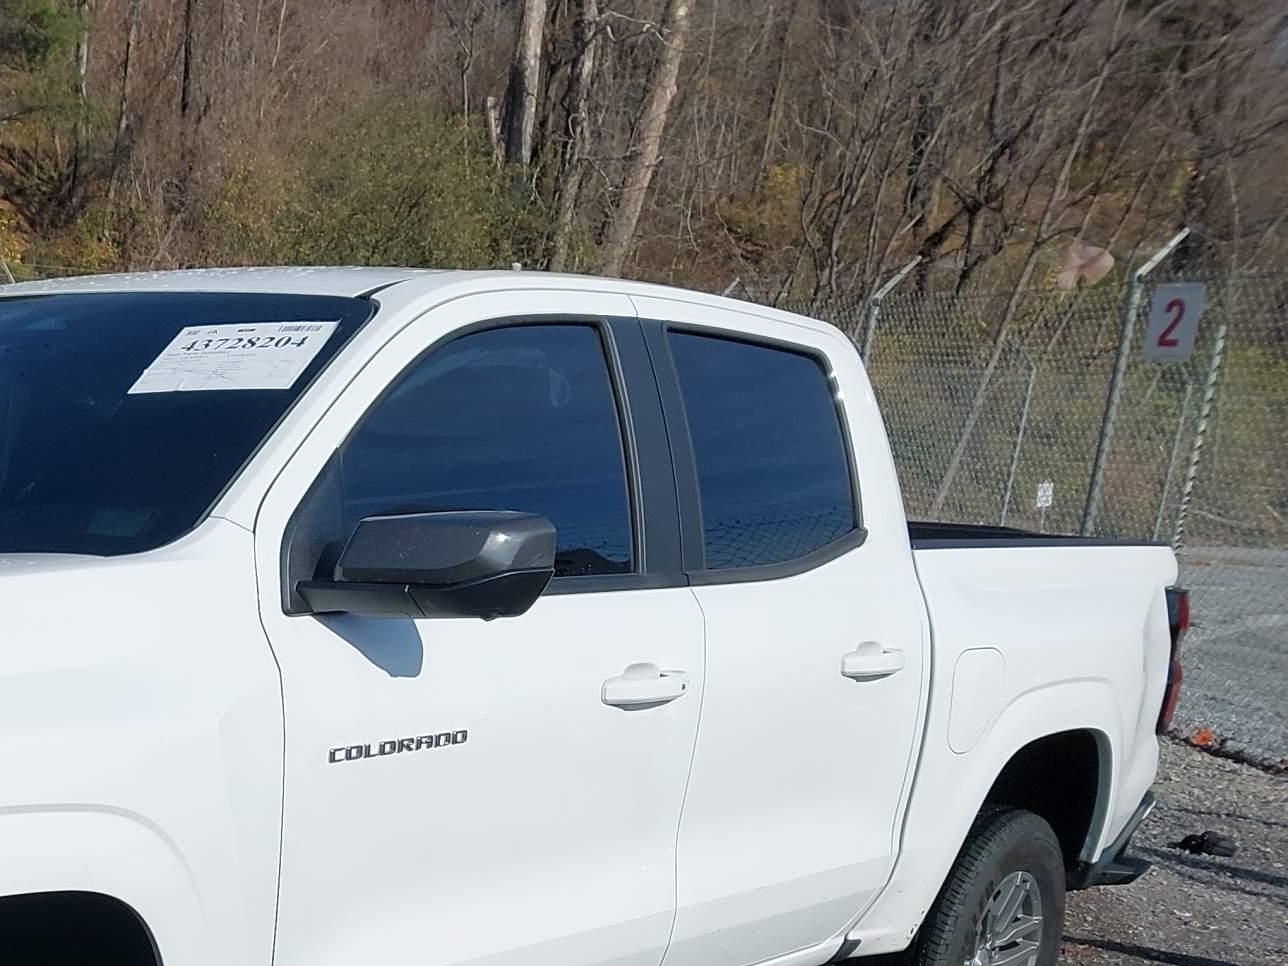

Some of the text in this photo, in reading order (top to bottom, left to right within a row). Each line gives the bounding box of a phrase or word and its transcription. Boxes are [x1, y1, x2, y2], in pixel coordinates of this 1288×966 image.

[1158, 298, 1186, 347] 2
[181, 336, 308, 351] 43728204
[328, 729, 468, 763] COLORADO
